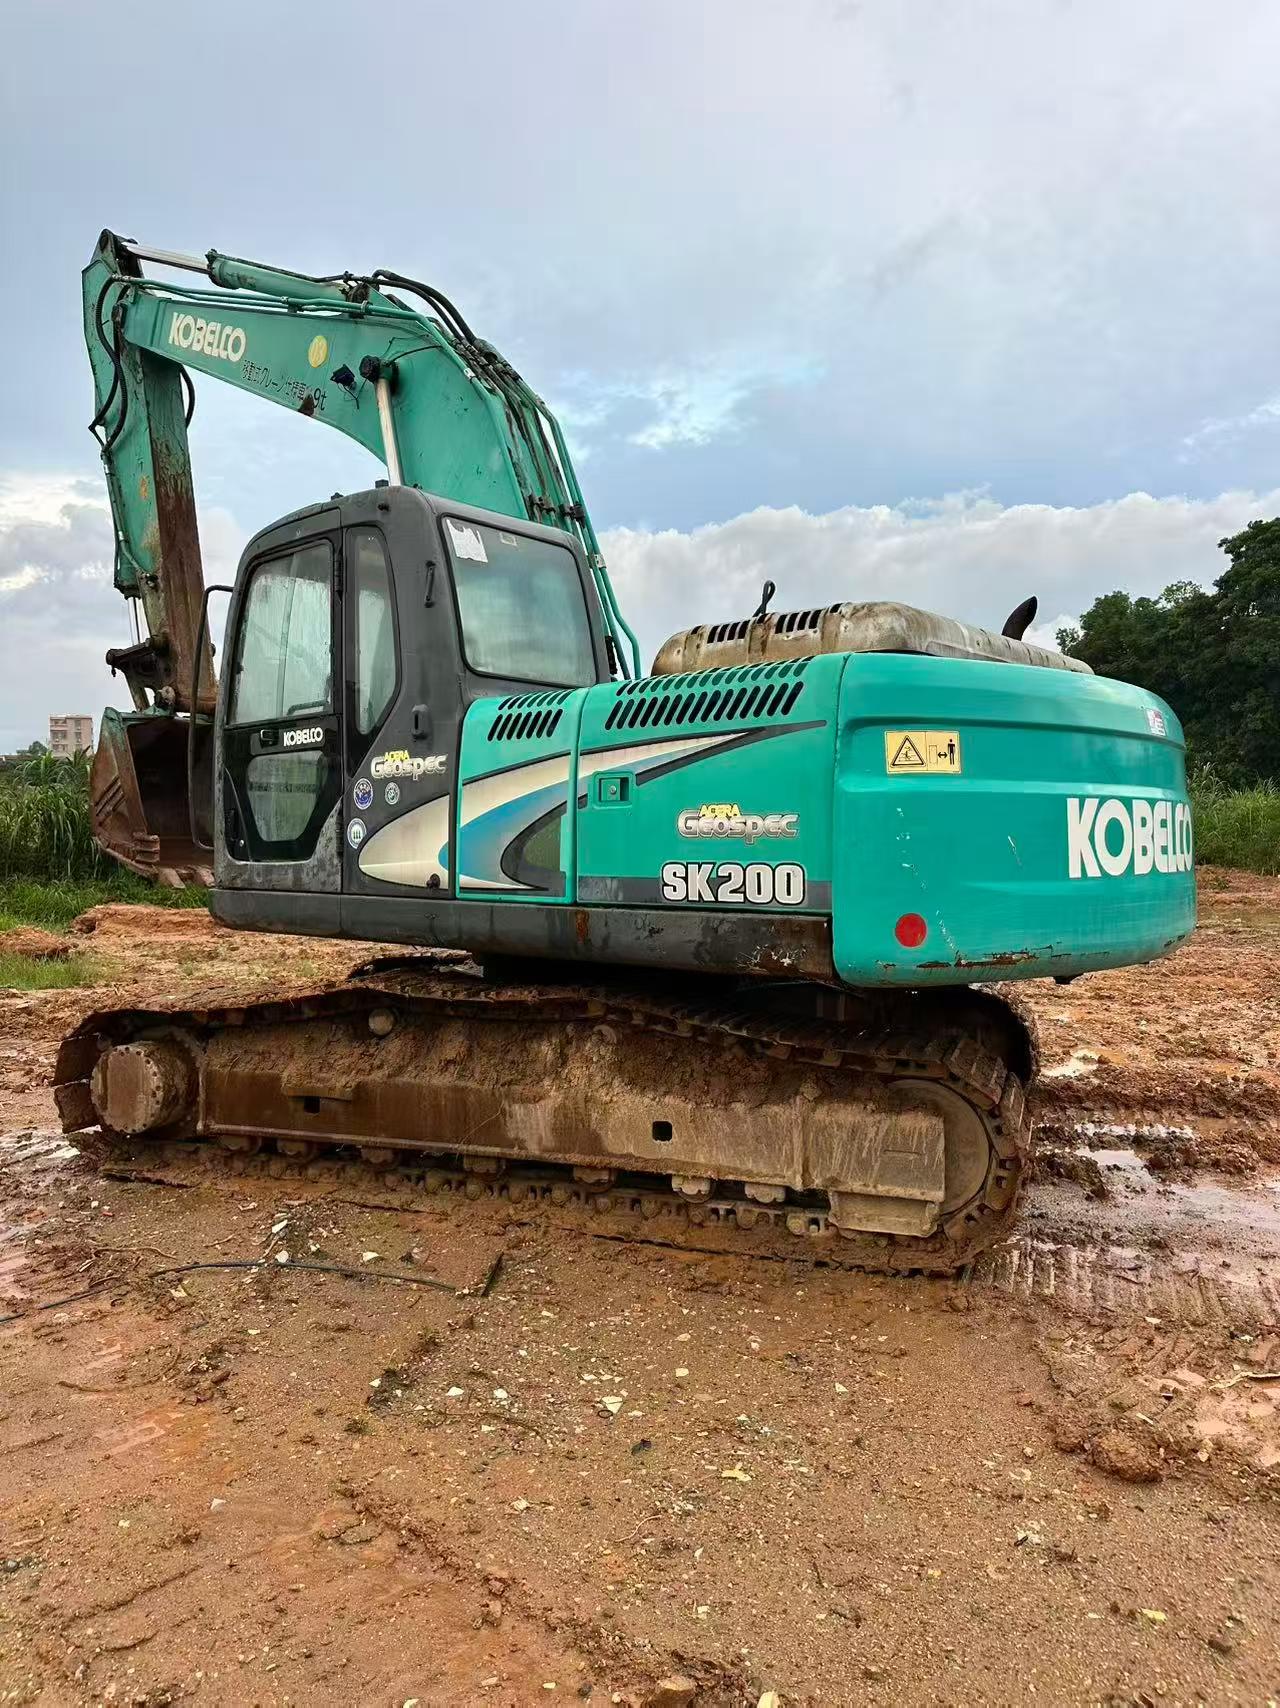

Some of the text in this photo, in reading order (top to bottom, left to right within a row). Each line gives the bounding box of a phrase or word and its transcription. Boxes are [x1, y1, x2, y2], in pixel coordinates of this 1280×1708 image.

[168, 311, 247, 363] KOBELCO
[283, 726, 324, 747] KOBELCO
[699, 803, 741, 819] ACERA
[1066, 797, 1194, 880] KOBELCO
[661, 861, 806, 905] SK200
